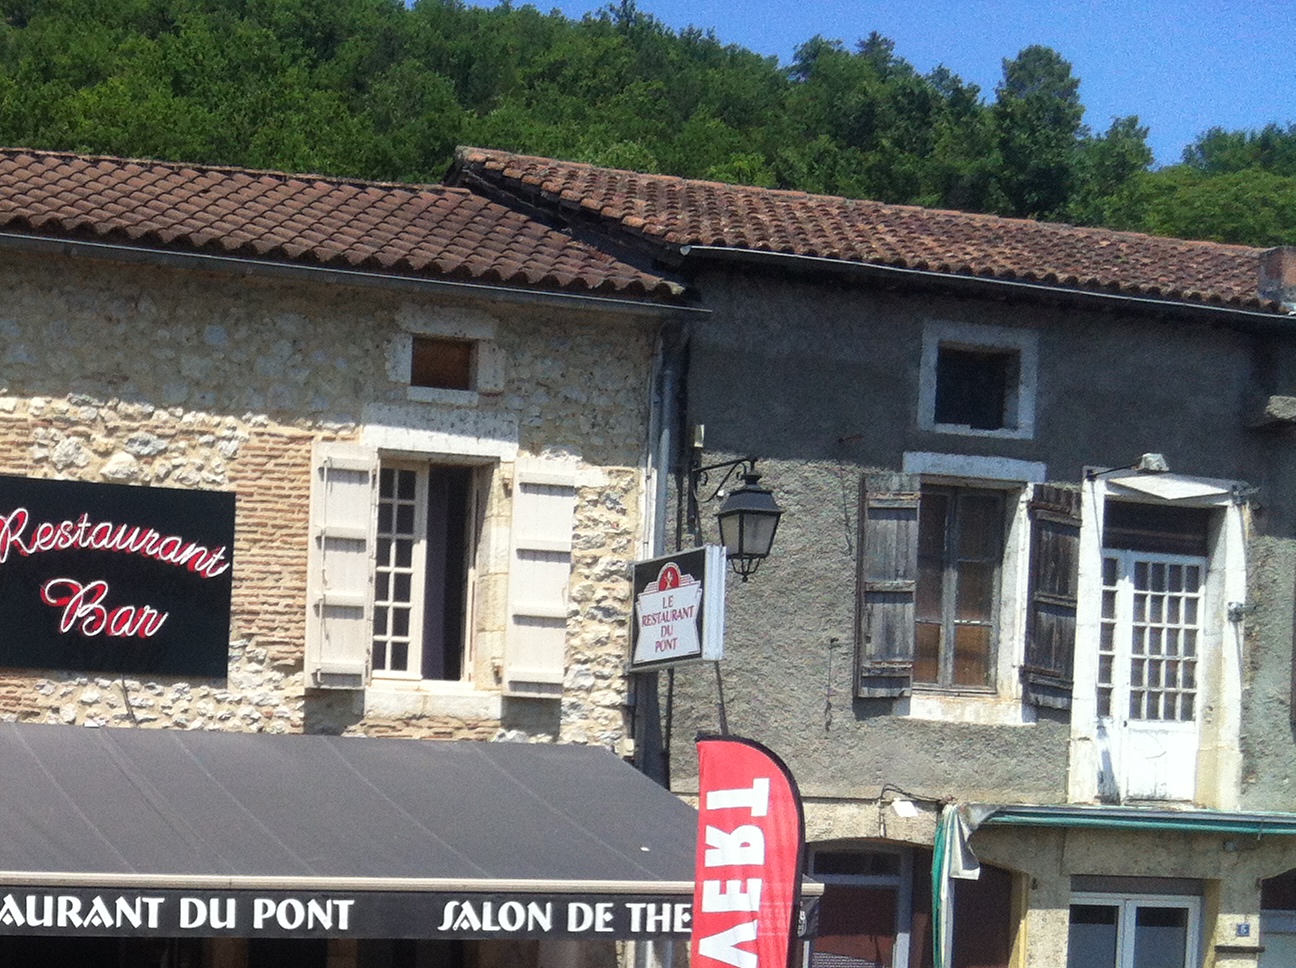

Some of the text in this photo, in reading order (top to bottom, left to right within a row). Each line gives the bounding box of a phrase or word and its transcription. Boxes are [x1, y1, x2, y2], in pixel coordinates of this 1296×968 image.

[40, 577, 169, 639] Bar
[662, 595, 675, 609] LE
[641, 605, 695, 628] RESTAURANT
[660, 624, 674, 638] DU
[655, 637, 679, 653] PONT
[179, 898, 236, 930] DU
[253, 898, 355, 932] PONT
[437, 899, 692, 933] SALON DE THE
